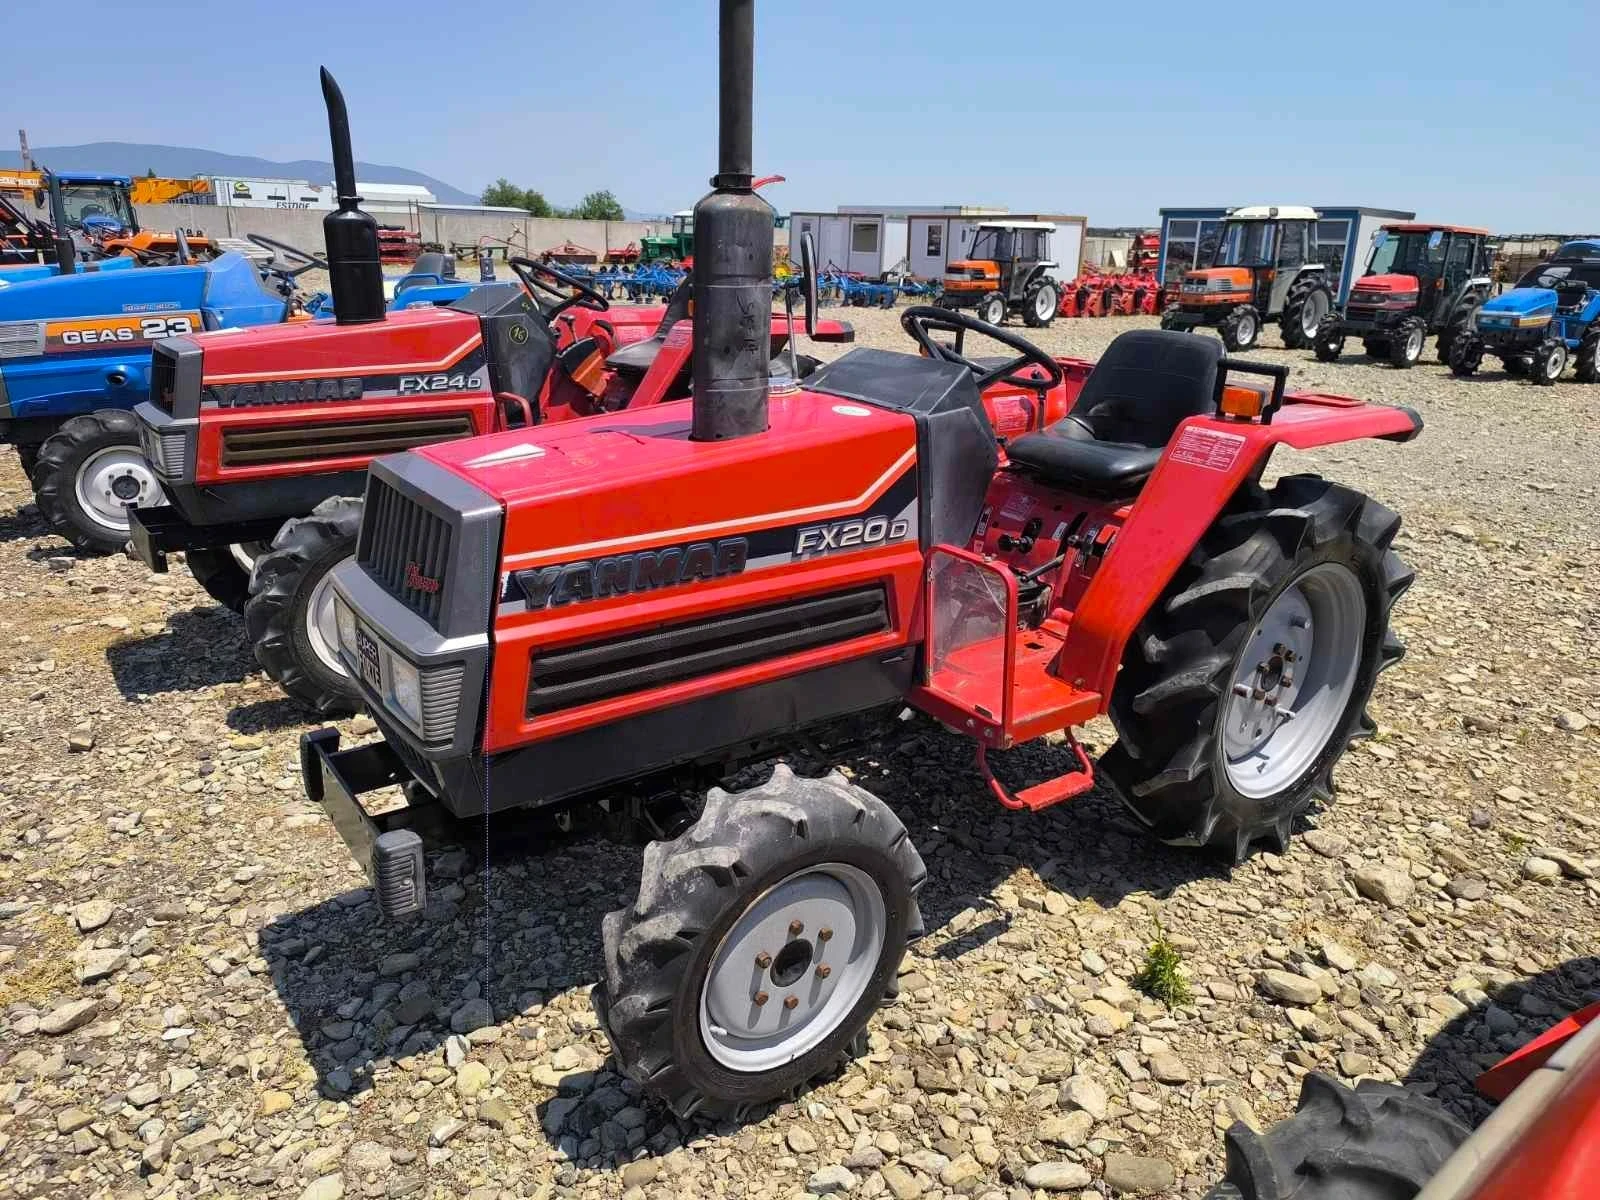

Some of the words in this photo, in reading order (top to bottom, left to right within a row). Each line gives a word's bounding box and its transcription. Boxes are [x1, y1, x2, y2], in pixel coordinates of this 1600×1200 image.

[62, 327, 133, 345] GEAS
[140, 316, 193, 339] 23
[399, 373, 482, 392] FX24D
[795, 516, 908, 555] FX20D
[516, 536, 748, 610] YANMAR
